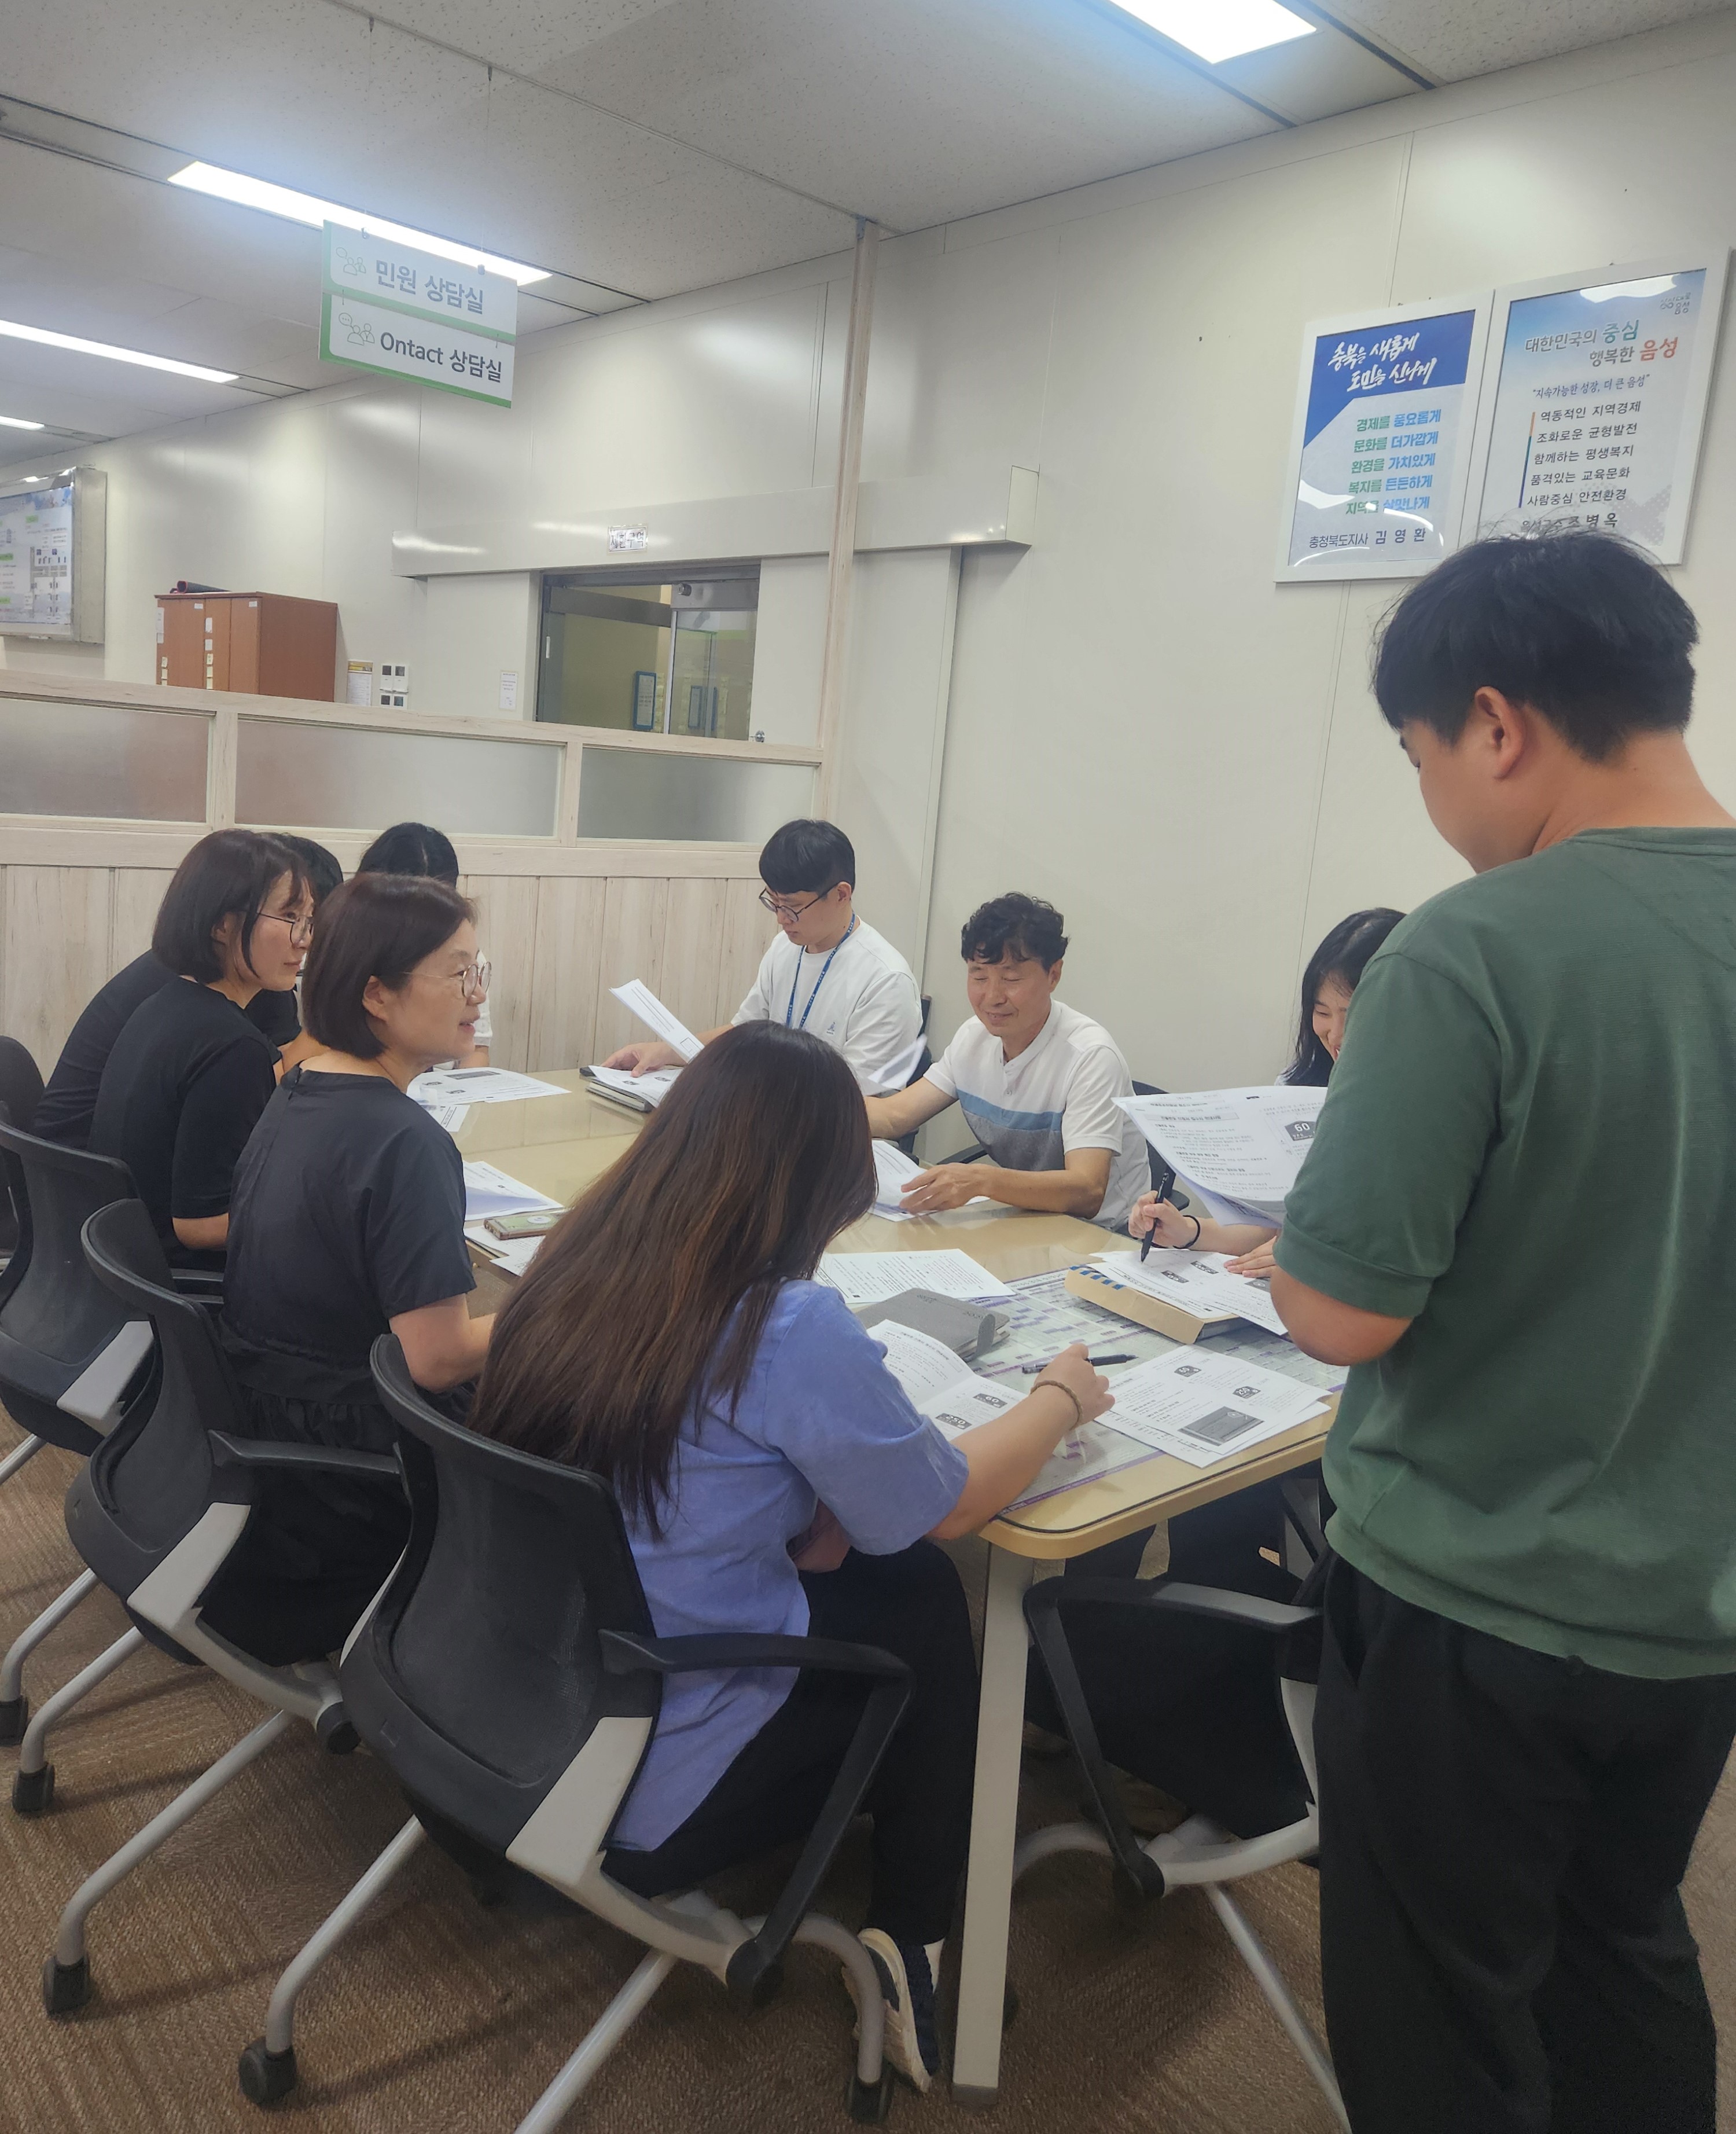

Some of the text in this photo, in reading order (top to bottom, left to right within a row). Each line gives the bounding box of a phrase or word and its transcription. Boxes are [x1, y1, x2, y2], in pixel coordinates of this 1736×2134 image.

[376, 260, 483, 314] 민원 상담실
[1525, 319, 1639, 352] 대한민국의 중심
[381, 332, 501, 383] Ontact 상담실
[1328, 333, 1419, 371] 충북을 새롭게
[1590, 336, 1678, 367] 행복한 음성
[1347, 357, 1437, 392] 도민을 신나게
[1580, 380, 1599, 394] 성장,
[1616, 378, 1624, 390] 큰
[1357, 409, 1441, 432] 경제를 풍요롭게
[1541, 401, 1641, 422] 역동적인 지역경제
[1354, 431, 1439, 453] 문화를 더가깝게
[1537, 423, 1637, 443] 조화로운 균형발전
[1352, 453, 1436, 473] 환경을 가치있게
[1535, 445, 1634, 465] 함께하는 평생복지
[1349, 475, 1433, 494] 복지를 든든하게
[1531, 467, 1630, 486] 품격있는 교육문화
[1527, 488, 1627, 506] 사람중심 안전환경
[1603, 513, 1618, 528] 옥
[611, 532, 643, 549] 제한구역
[1310, 528, 1426, 548] 충청북도지사 김 영 환
[1294, 1123, 1310, 1132] 60
[946, 1416, 965, 1424] 250
